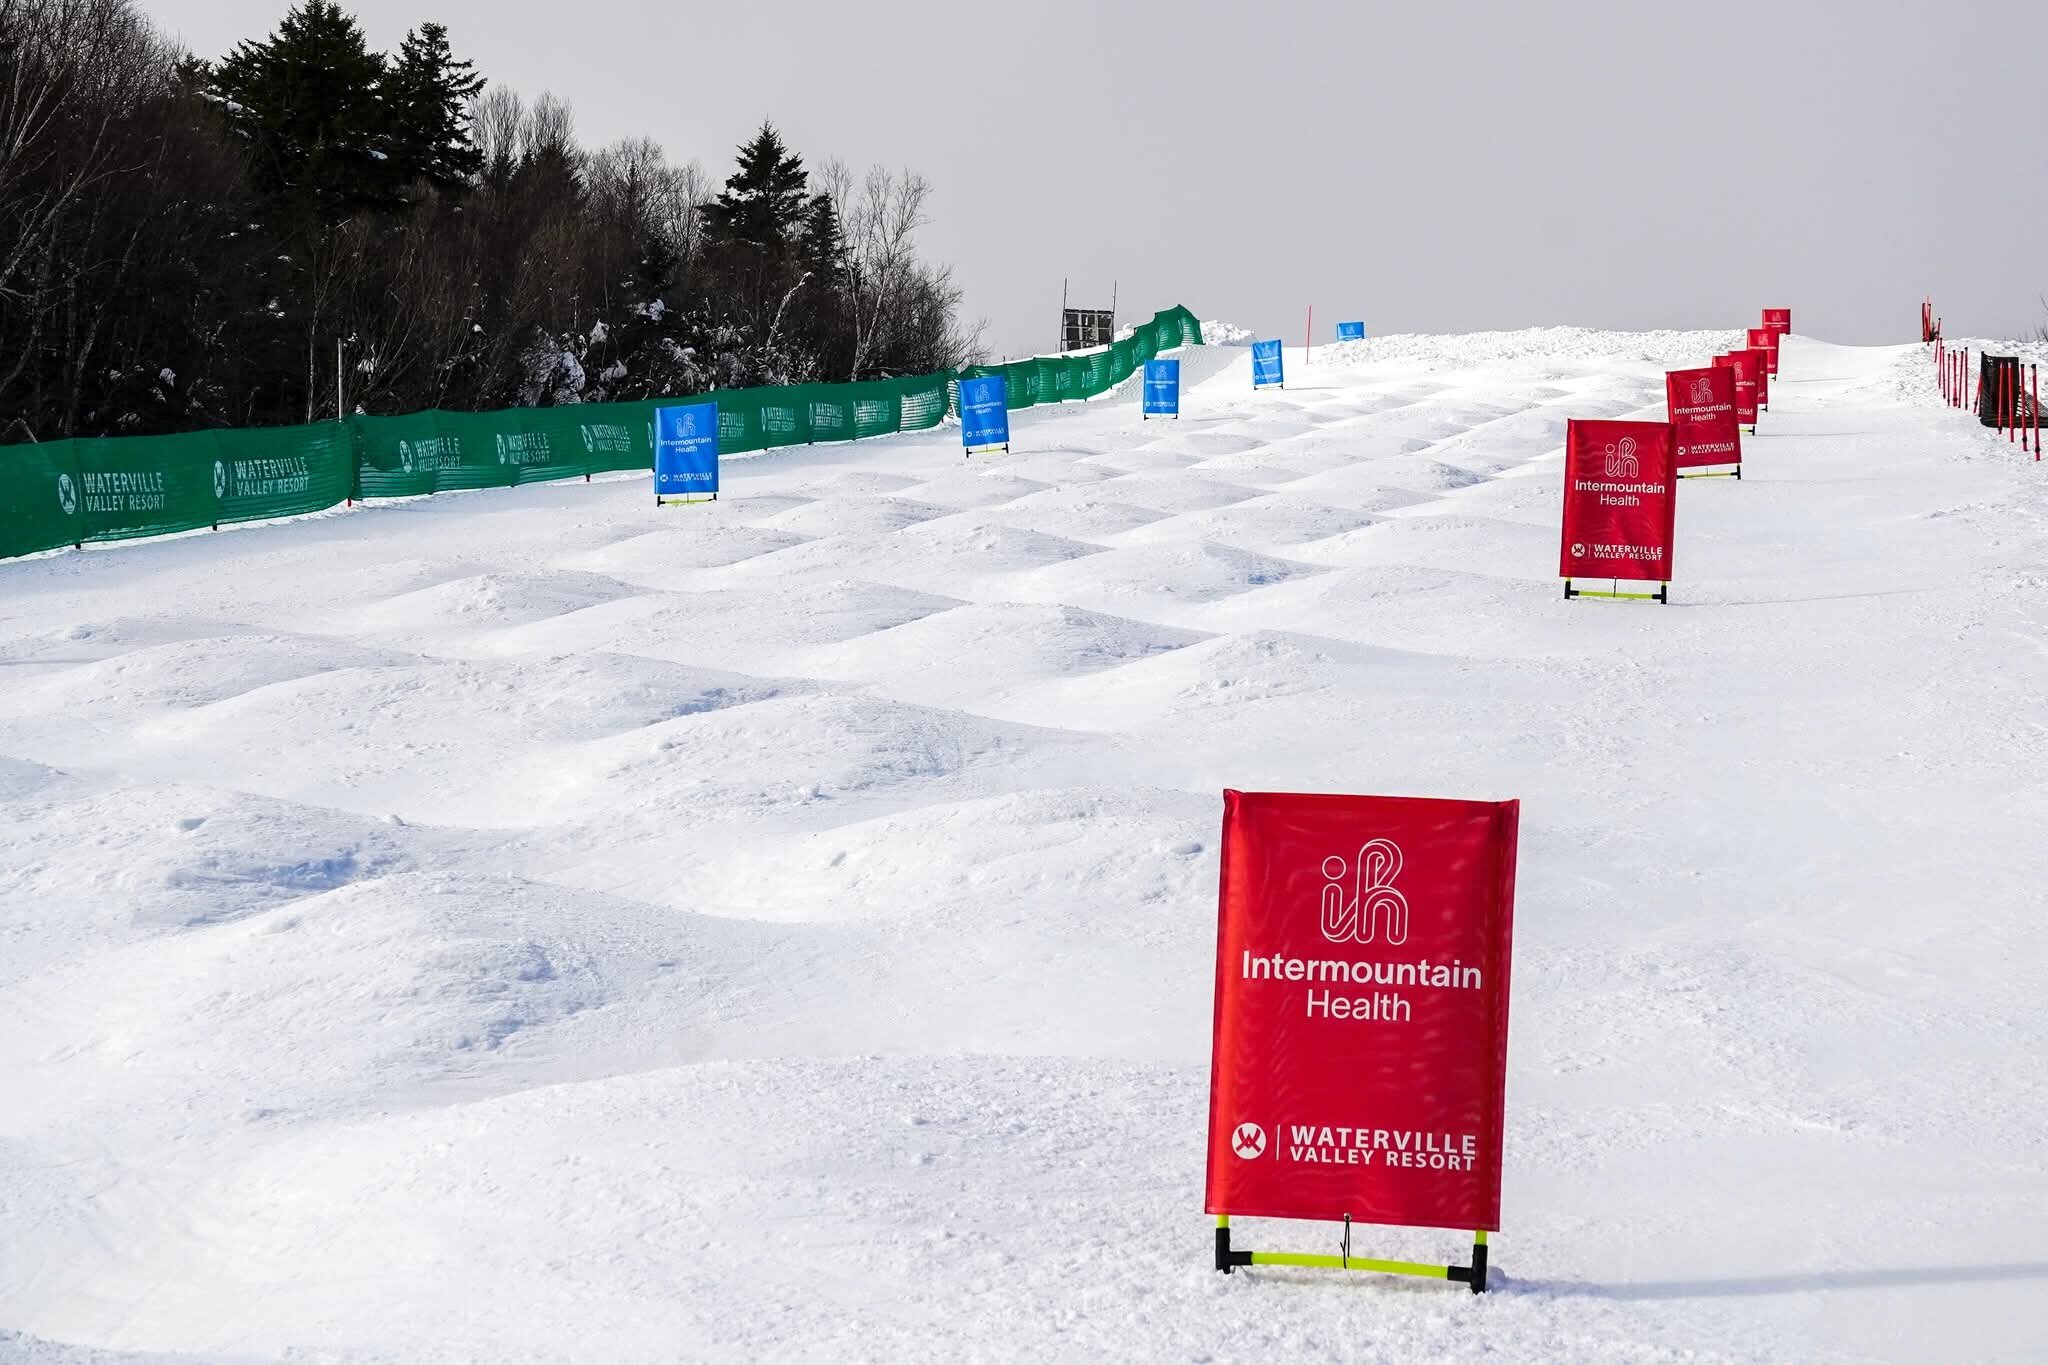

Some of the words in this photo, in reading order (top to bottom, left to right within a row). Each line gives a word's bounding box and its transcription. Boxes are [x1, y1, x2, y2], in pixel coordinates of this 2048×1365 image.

[1674, 404, 1732, 415] Intermountain
[1691, 413, 1716, 422] Health
[660, 436, 712, 447] Intermountain
[234, 456, 309, 479] WATERVILLE
[83, 472, 164, 494] WATERVILLE
[236, 480, 273, 496] VALLEY
[278, 476, 309, 494] RESORT
[1575, 479, 1665, 494] Intermountain
[86, 495, 124, 512] VALLEY
[129, 494, 165, 510] RESORT
[1600, 494, 1640, 507] Health
[1594, 544, 1663, 555] WATERVILLE
[1243, 950, 1482, 989] Intermountain
[1307, 989, 1411, 1022] Health
[1291, 1125, 1476, 1155] WATERVILLE
[1290, 1146, 1374, 1165] VALLEY
[1386, 1151, 1476, 1171] RESORT
